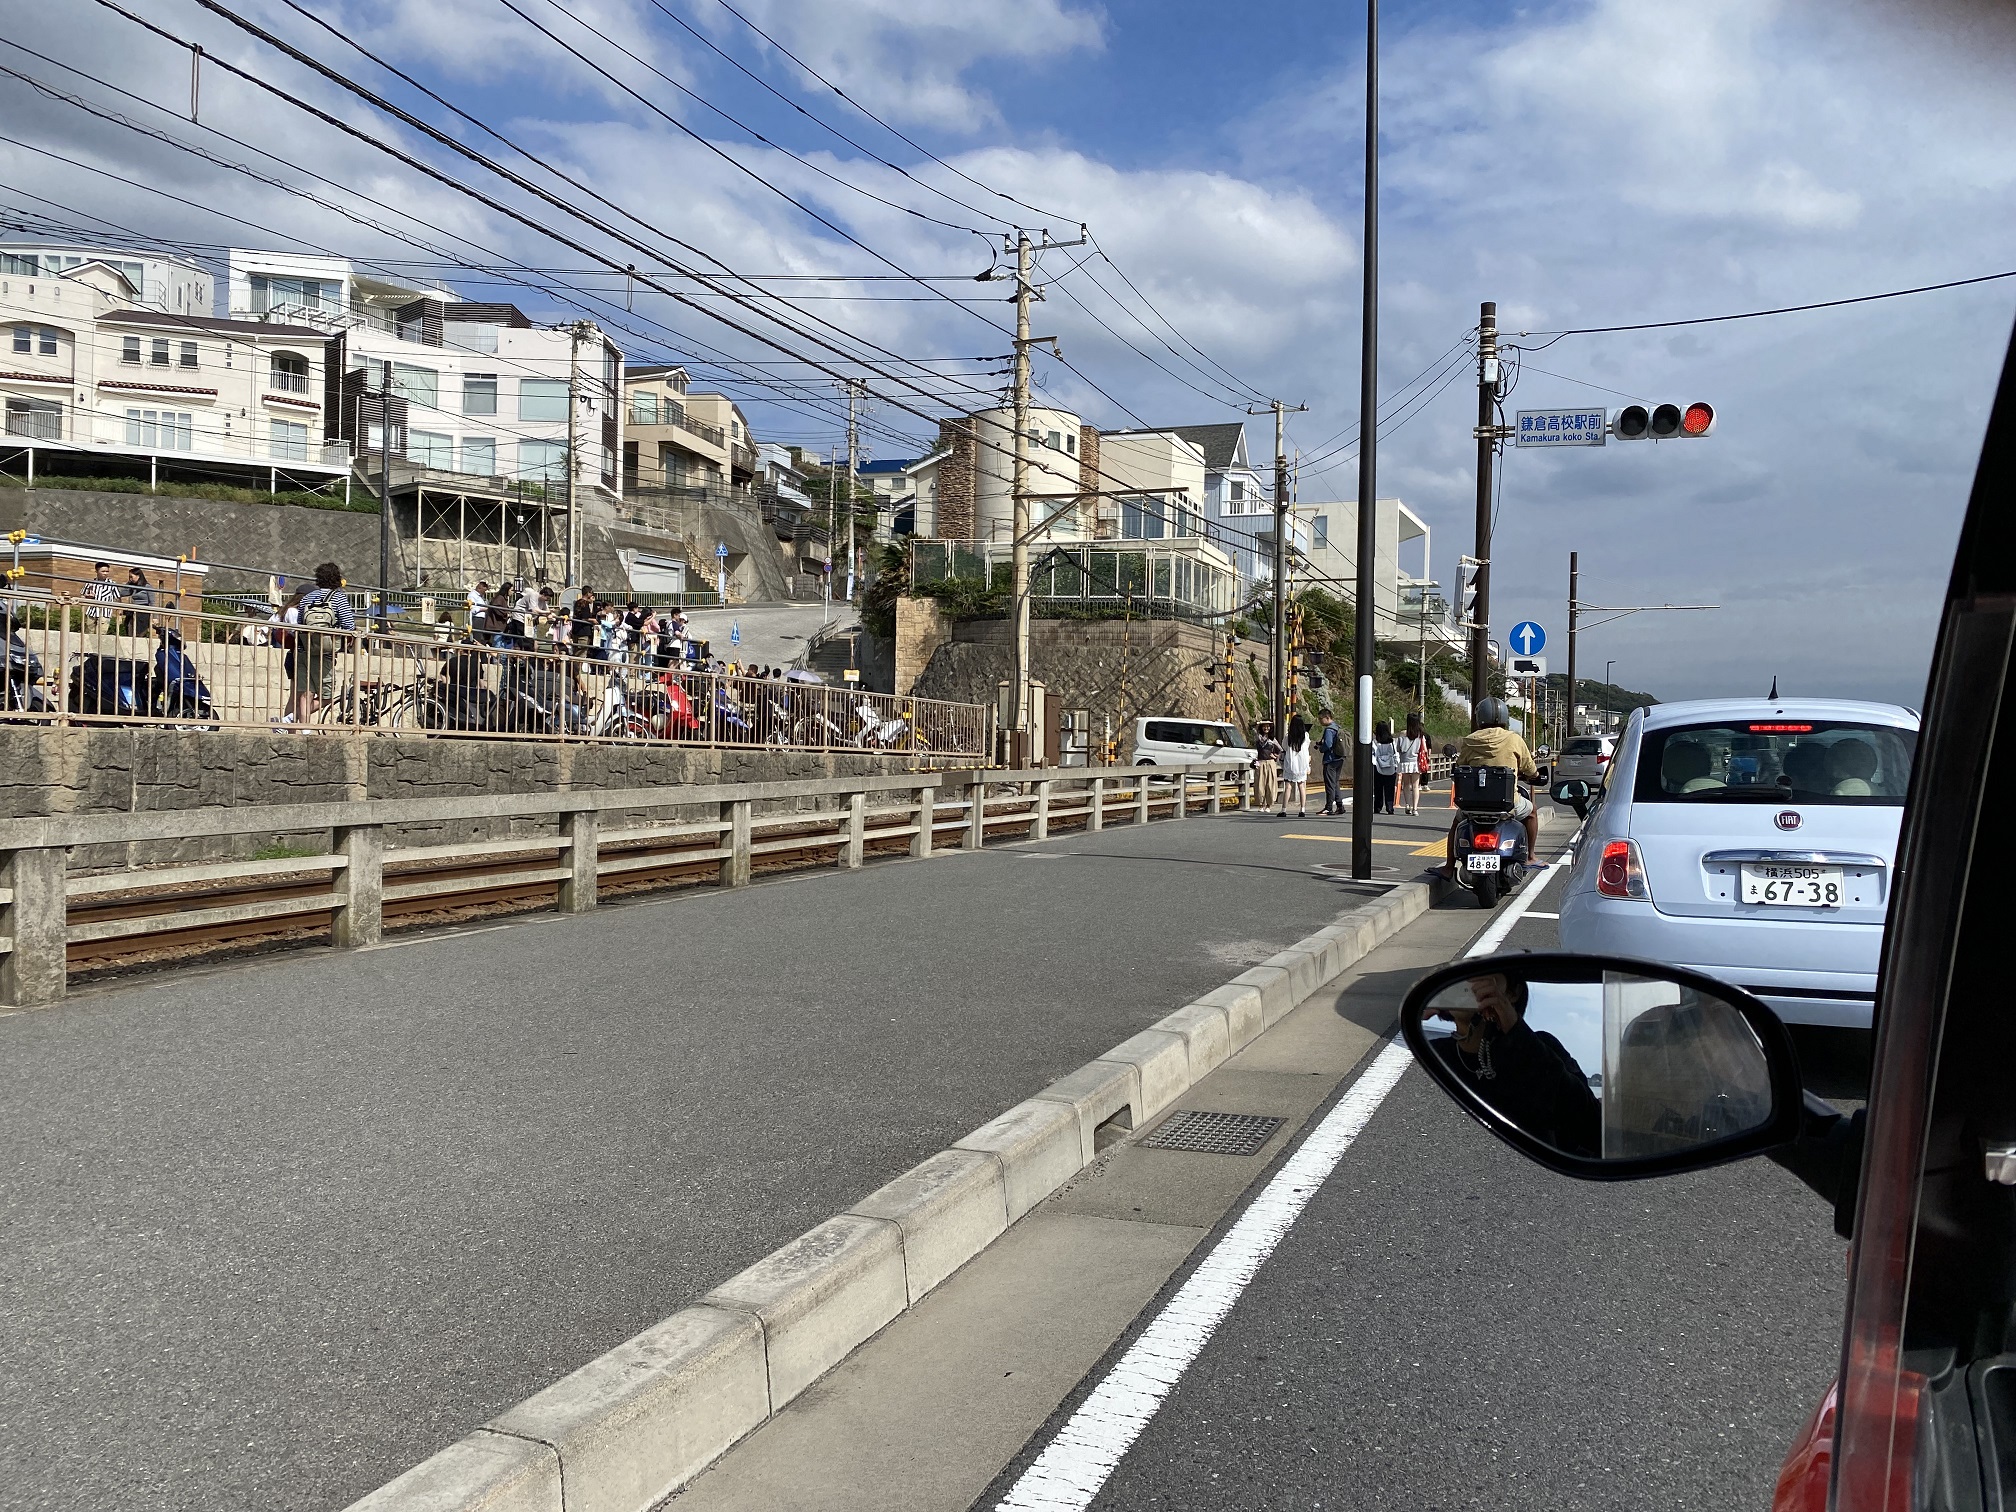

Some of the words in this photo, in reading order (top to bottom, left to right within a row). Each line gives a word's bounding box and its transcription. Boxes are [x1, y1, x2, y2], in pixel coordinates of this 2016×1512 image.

[1520, 413, 1601, 432] 鎌倉高校駅前
[1520, 434, 1560, 443] Kamakura
[1563, 433, 1582, 441] koko
[1781, 815, 1798, 825] FIAT
[1764, 881, 1839, 903] 67-38
